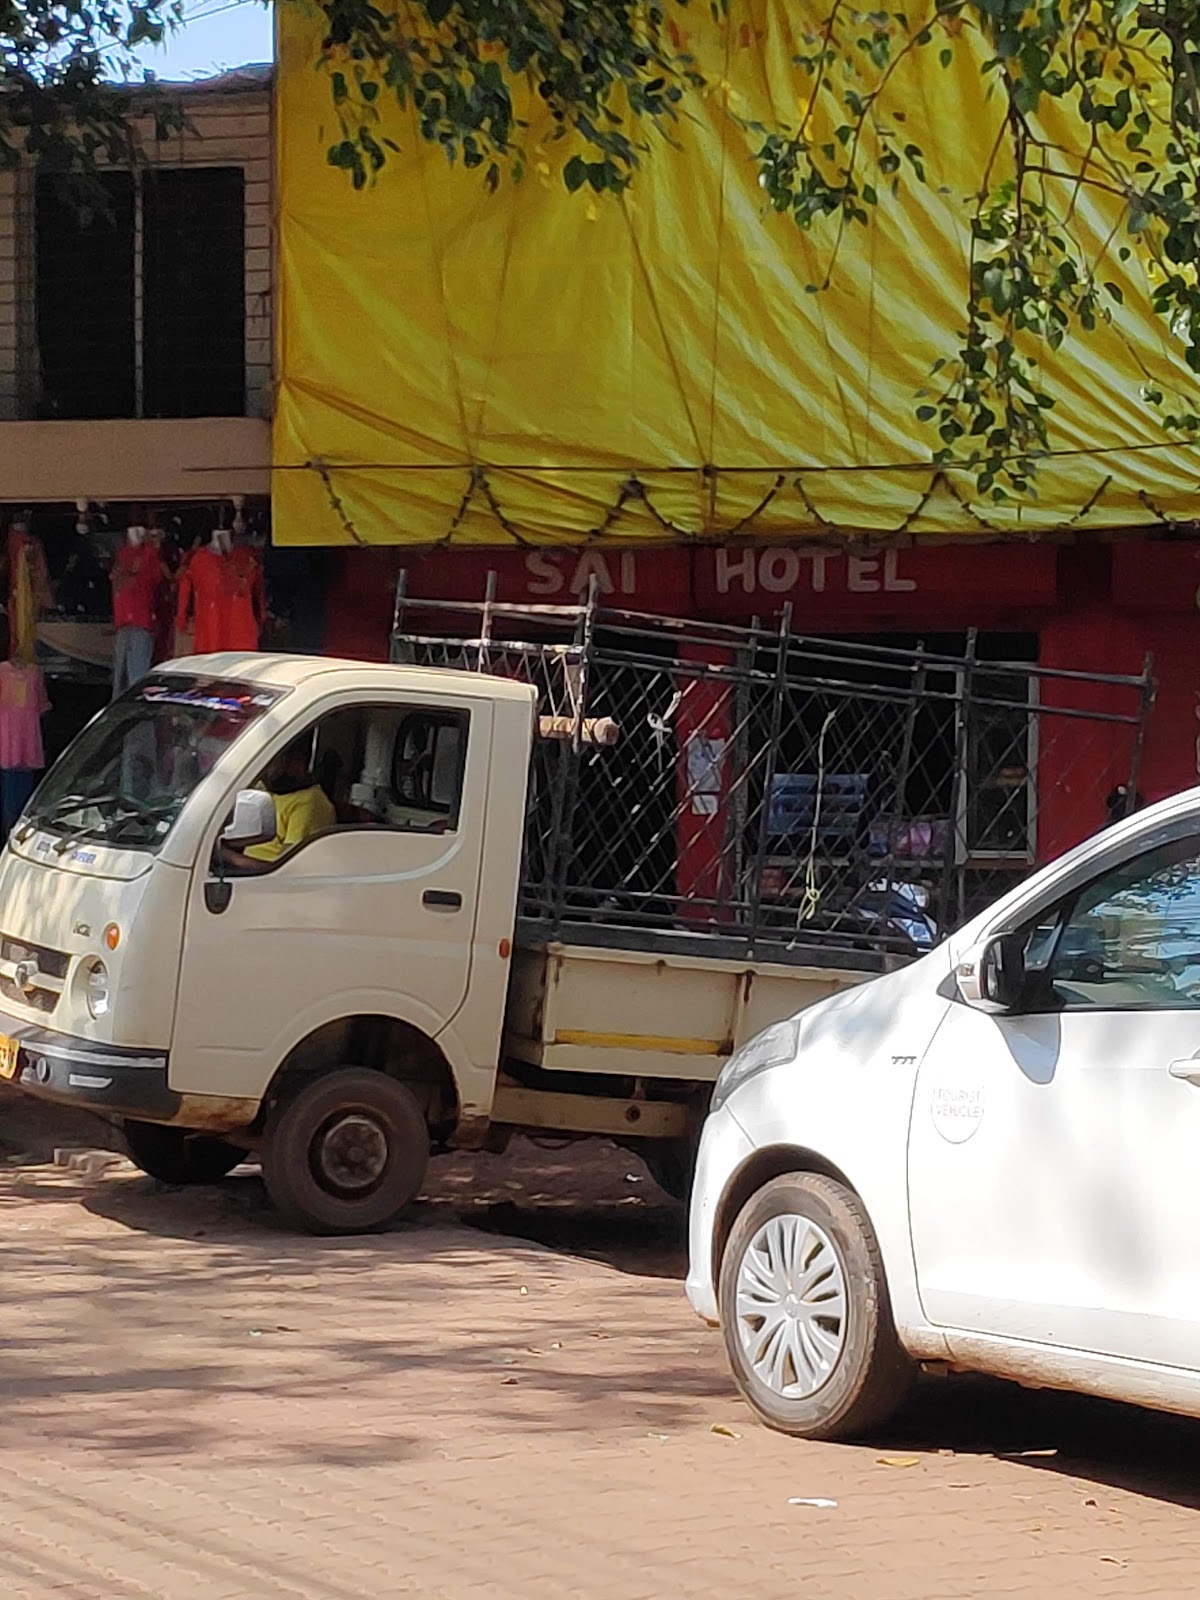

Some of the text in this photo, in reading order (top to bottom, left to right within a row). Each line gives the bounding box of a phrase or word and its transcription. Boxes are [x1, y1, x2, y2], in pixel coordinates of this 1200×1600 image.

[525, 547, 918, 595] SAI HOTEL
[935, 1104, 980, 1118] VEHICLE
